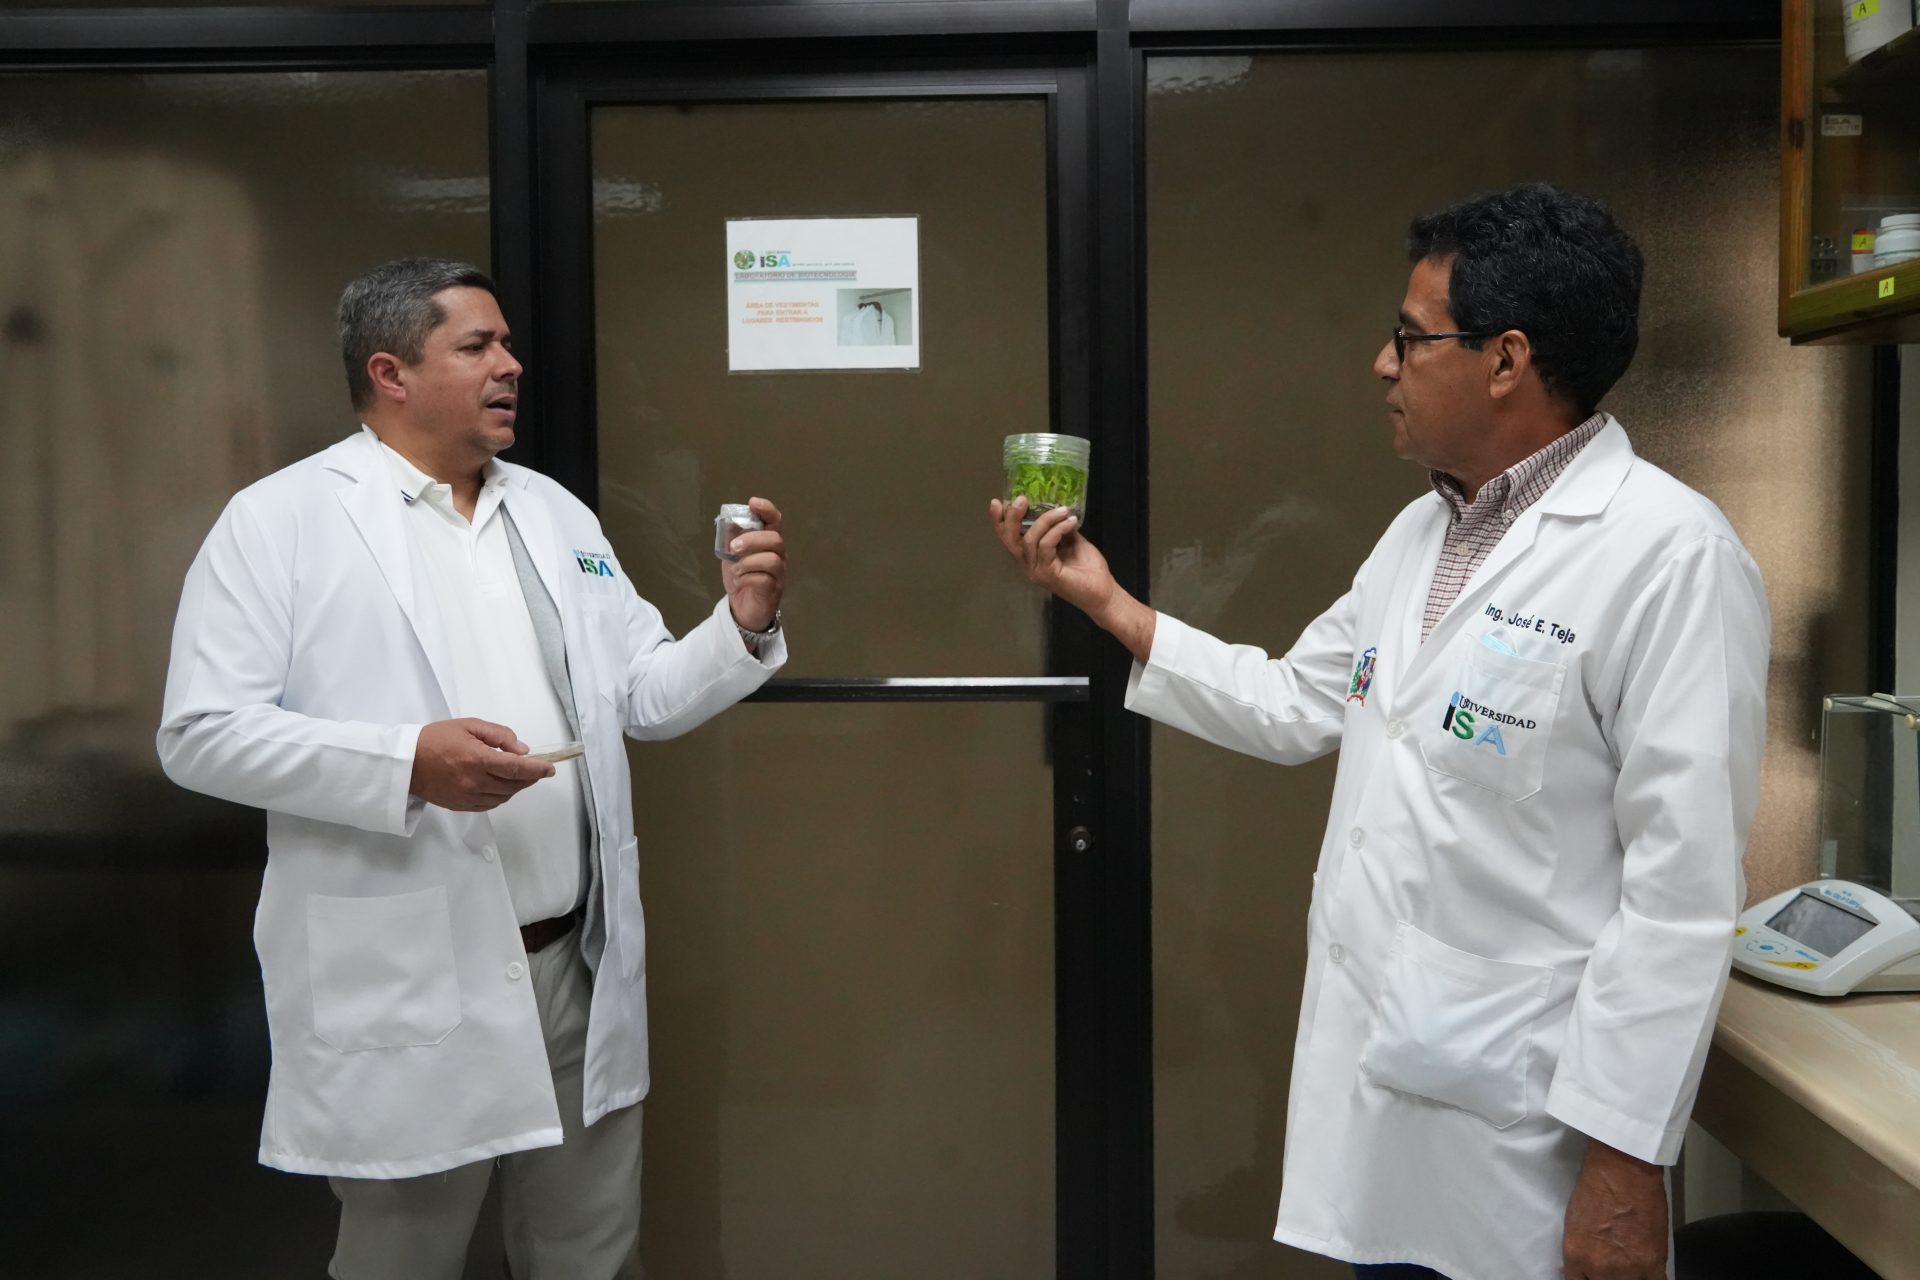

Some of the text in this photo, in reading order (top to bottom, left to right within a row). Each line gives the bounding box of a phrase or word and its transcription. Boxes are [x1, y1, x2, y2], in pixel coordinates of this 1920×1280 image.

[1485, 602, 1577, 645] Ing. José E. Teja
[1459, 695, 1537, 730] UNIVERSIDAD
